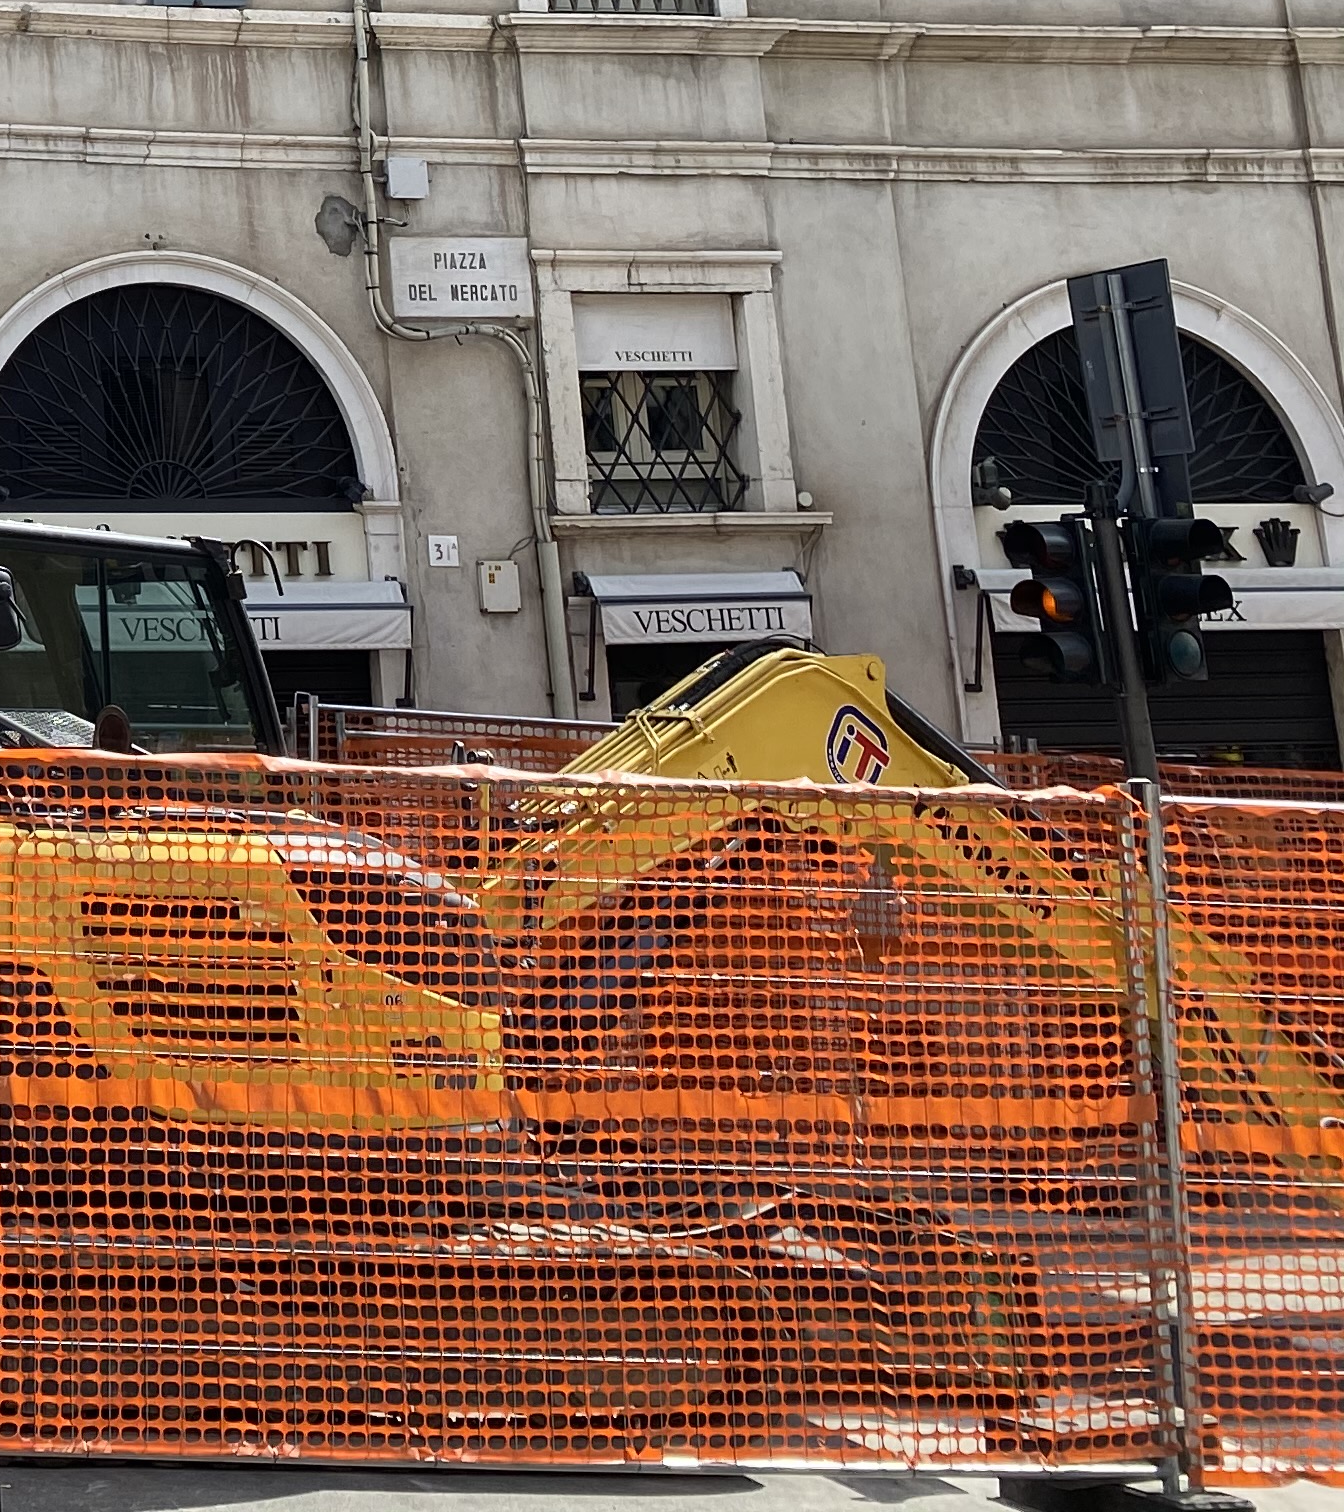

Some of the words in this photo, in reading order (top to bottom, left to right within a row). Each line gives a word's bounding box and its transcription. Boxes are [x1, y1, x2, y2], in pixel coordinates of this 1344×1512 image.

[433, 252, 487, 270] PIAZZA
[408, 283, 438, 302] DEL
[614, 350, 693, 363] VESCHETTI
[632, 606, 787, 635] VESCHETTI
